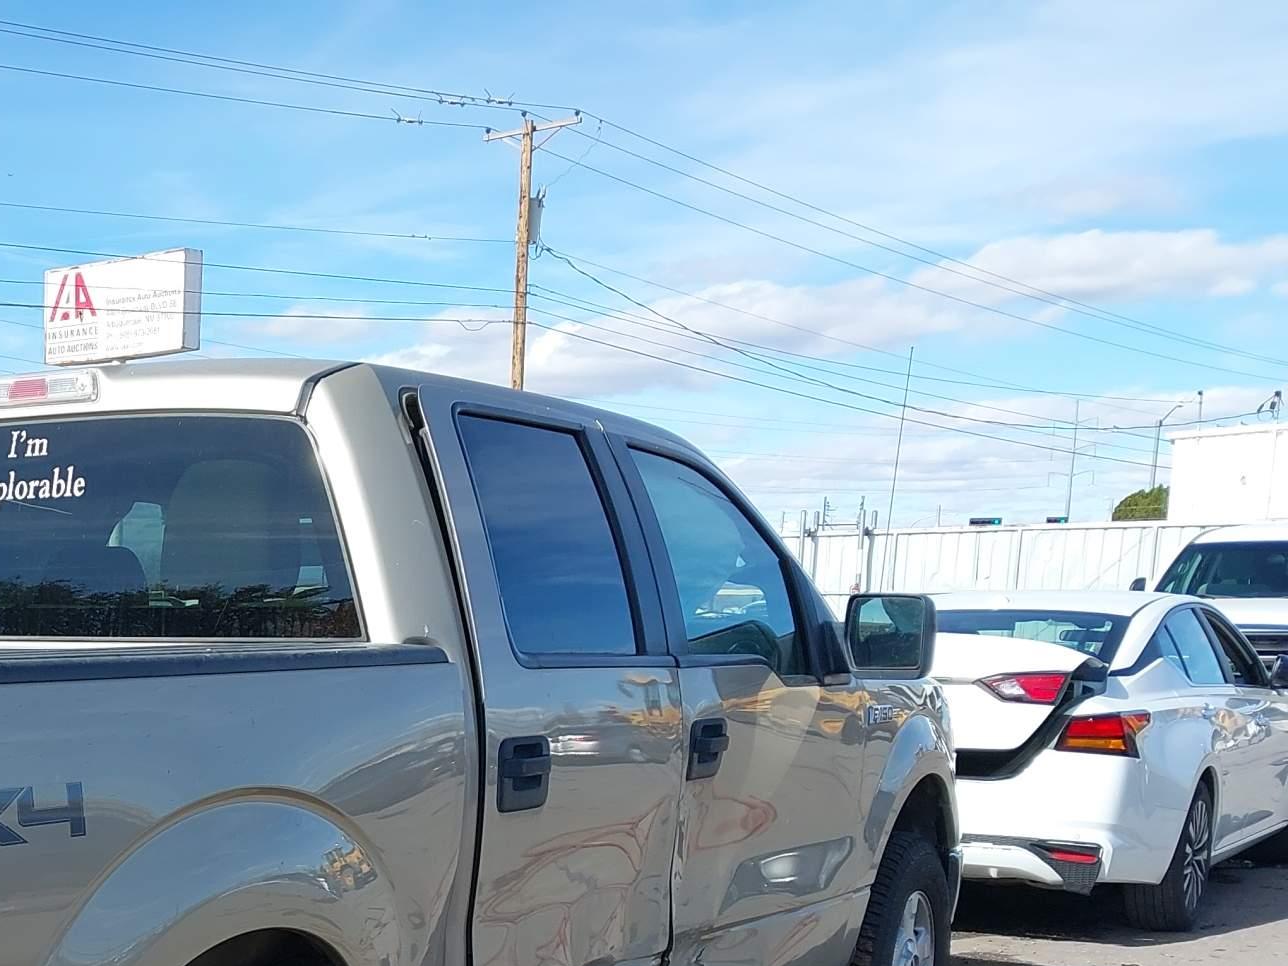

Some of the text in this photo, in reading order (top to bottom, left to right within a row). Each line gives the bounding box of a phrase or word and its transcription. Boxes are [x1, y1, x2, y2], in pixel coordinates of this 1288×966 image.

[48, 326, 98, 340] INSURANCE
[48, 345, 65, 355] AUTO
[67, 342, 98, 353] AUCTIONS
[8, 430, 48, 458] I'm
